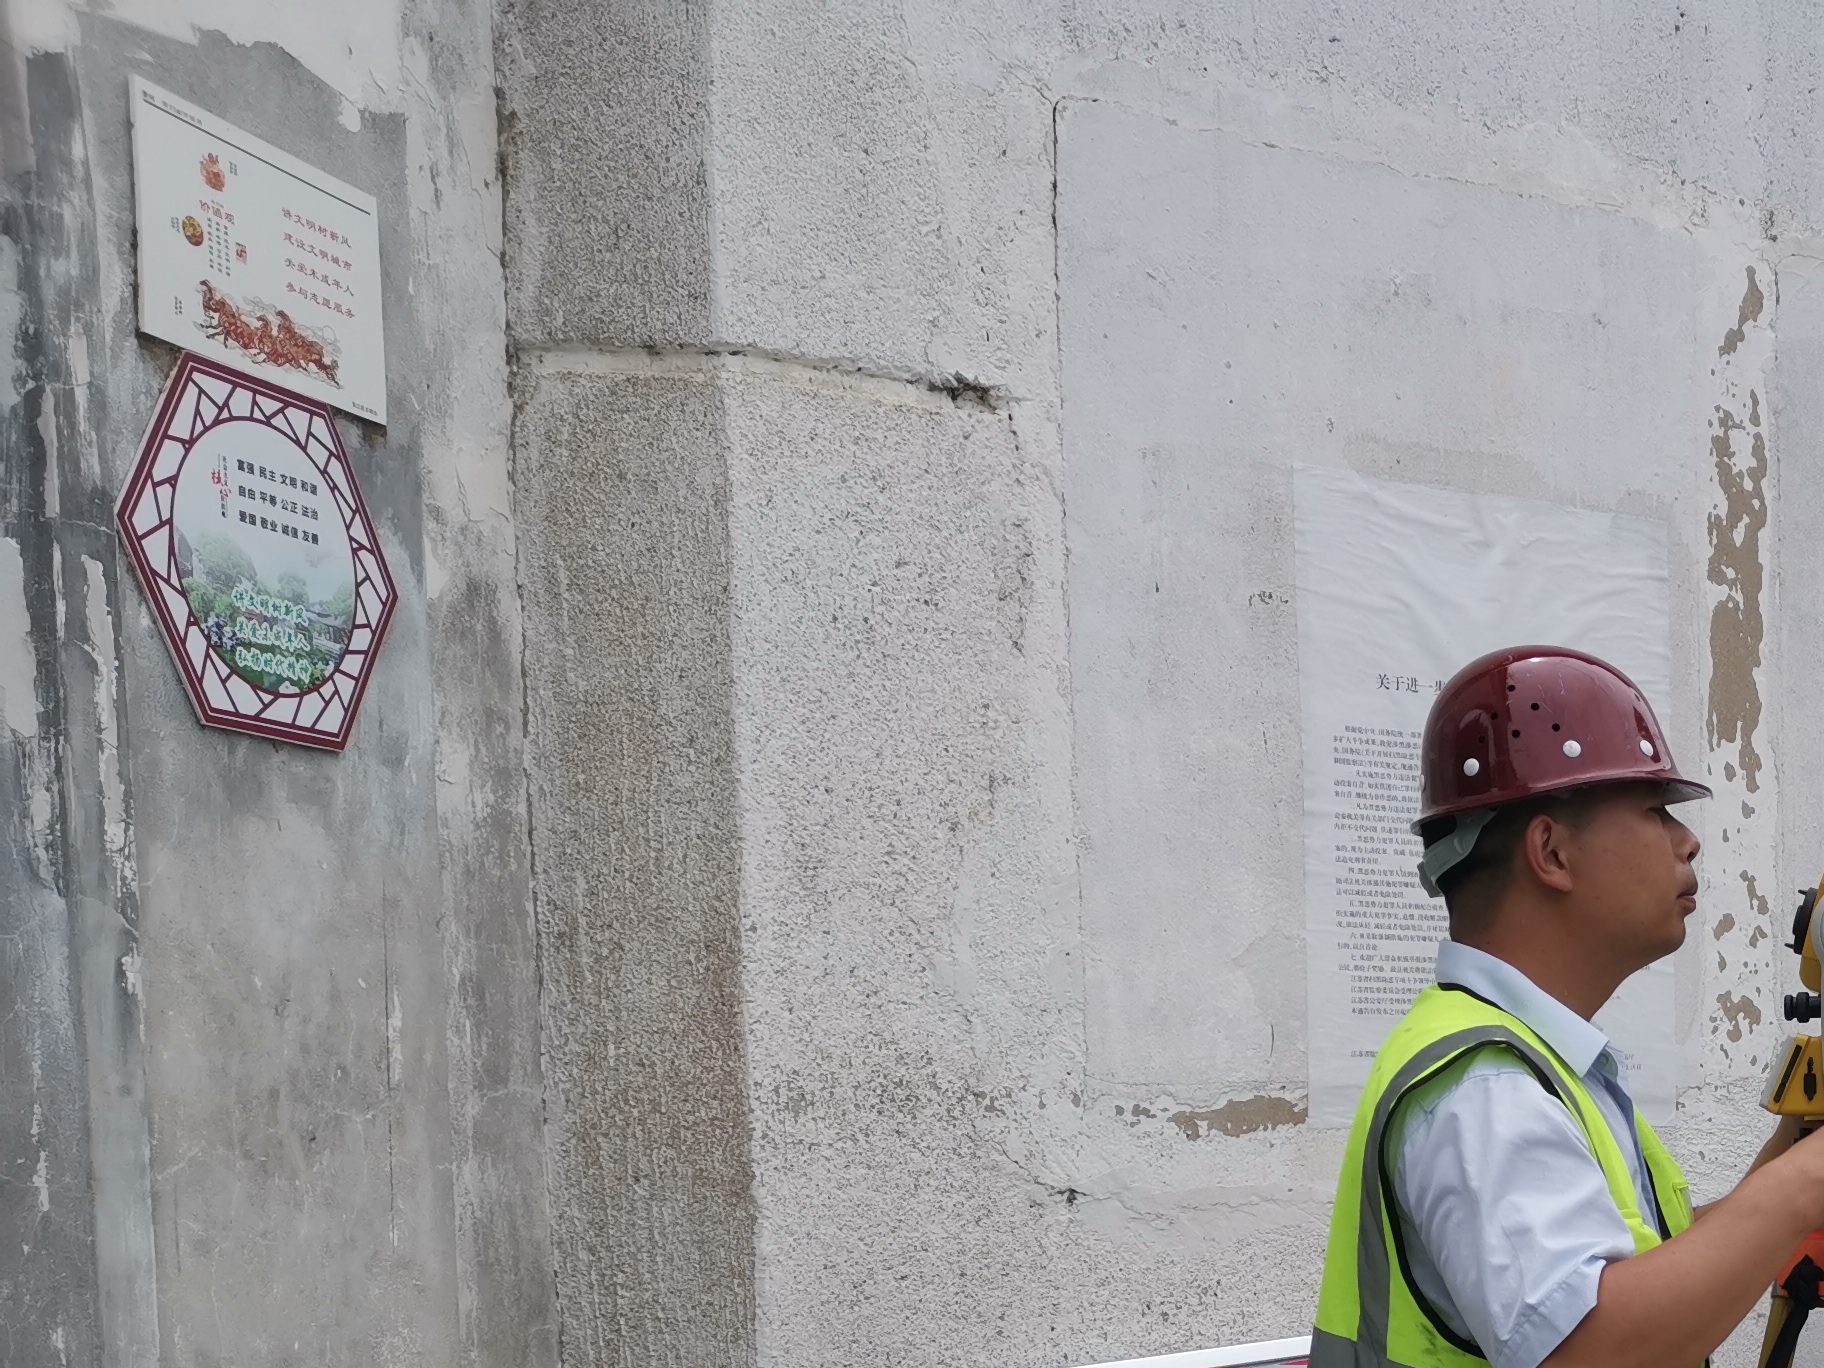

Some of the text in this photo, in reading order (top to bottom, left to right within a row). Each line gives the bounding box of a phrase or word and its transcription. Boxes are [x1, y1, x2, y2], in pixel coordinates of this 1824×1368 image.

[259, 466, 277, 482] 民主
[280, 473, 298, 489] 文明
[301, 480, 318, 496] 和谐
[238, 485, 318, 521] 自由 平等 公正 法治
[239, 510, 319, 545] 爱国 敬业 诚信 友善
[1376, 673, 1446, 696] 关于进一步
